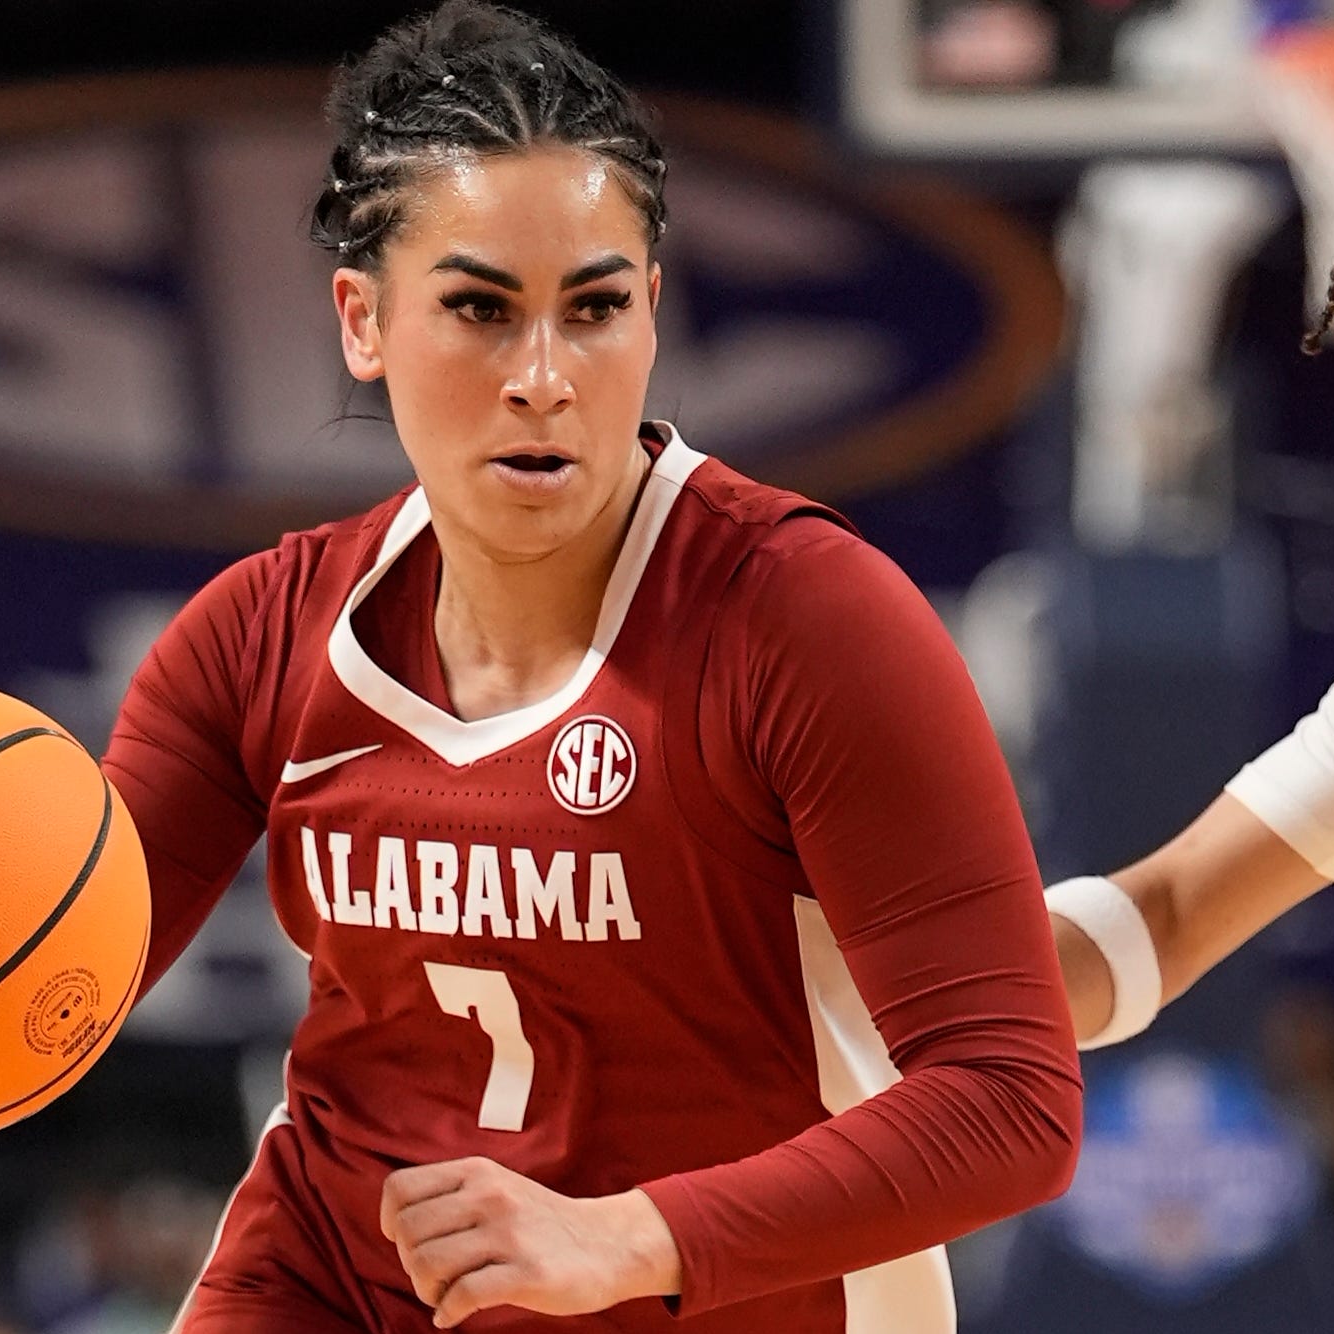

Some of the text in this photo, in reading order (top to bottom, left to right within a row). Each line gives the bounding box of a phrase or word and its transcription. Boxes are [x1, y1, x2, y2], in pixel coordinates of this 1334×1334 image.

[556, 723, 627, 806] SEC
[301, 826, 641, 941] ALABAMA
[423, 961, 535, 1132] 7
